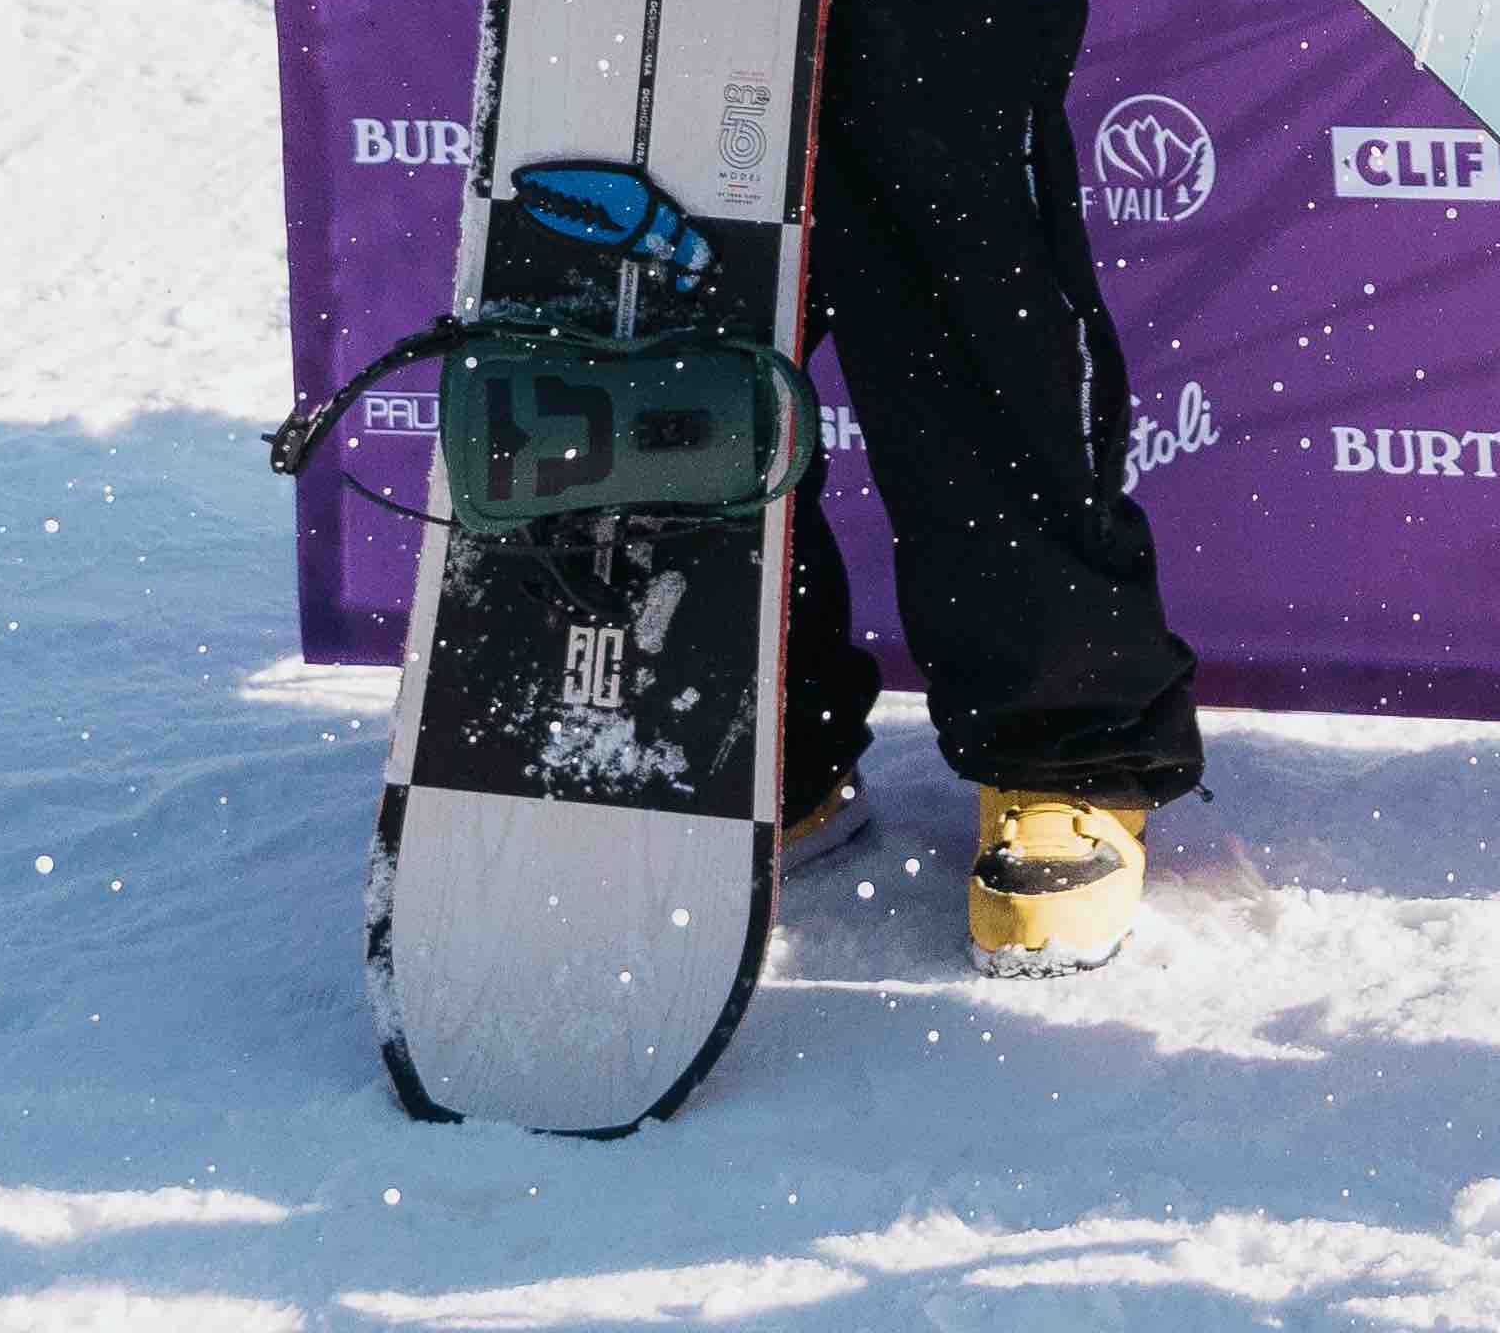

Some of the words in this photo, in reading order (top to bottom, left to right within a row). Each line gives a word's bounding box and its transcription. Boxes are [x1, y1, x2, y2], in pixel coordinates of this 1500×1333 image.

[1355, 139, 1483, 188] CLIF
[1103, 185, 1170, 224] VAIL
[364, 394, 441, 431] PAU
